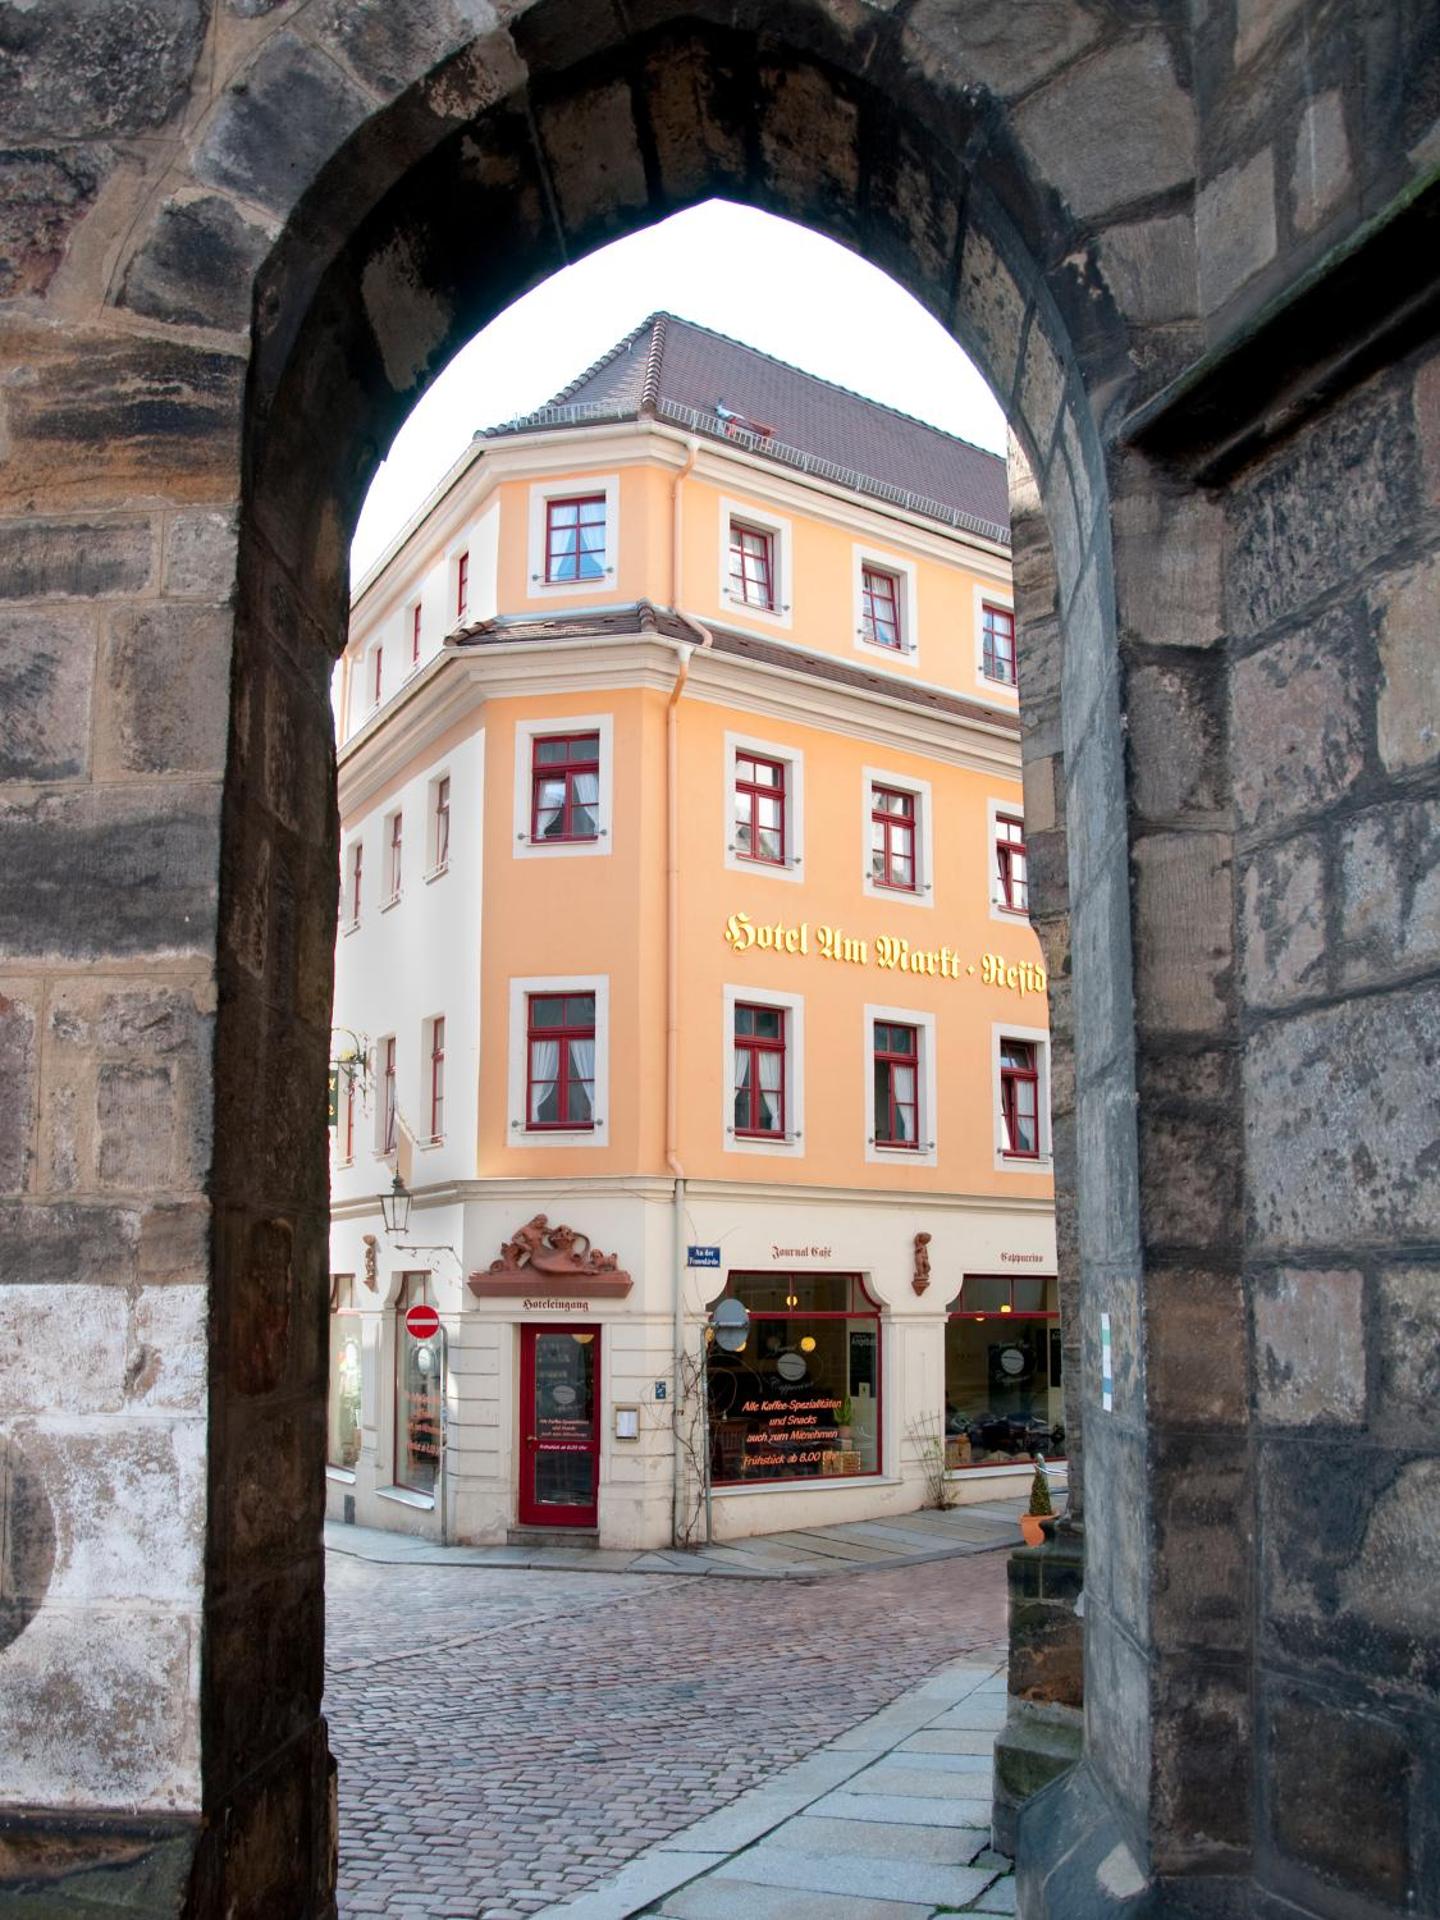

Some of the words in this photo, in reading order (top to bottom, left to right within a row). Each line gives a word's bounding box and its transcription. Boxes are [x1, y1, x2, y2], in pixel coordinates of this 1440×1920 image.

[724, 912, 808, 955] Hotel
[817, 925, 867, 965] Am
[876, 935, 960, 979] Markt
[772, 1246, 809, 1259] Journal
[523, 1299, 589, 1312] Hoteleingang
[742, 1401, 759, 1411] Alle
[769, 1416, 787, 1426] und
[788, 1415, 818, 1425] Snacks
[747, 1433, 768, 1442] auch
[769, 1432, 788, 1442] zum
[790, 1430, 838, 1440] Mitnehmen
[743, 1454, 784, 1467] Frühstück
[787, 1453, 798, 1463] ab
[799, 1452, 820, 1463] 8.00
